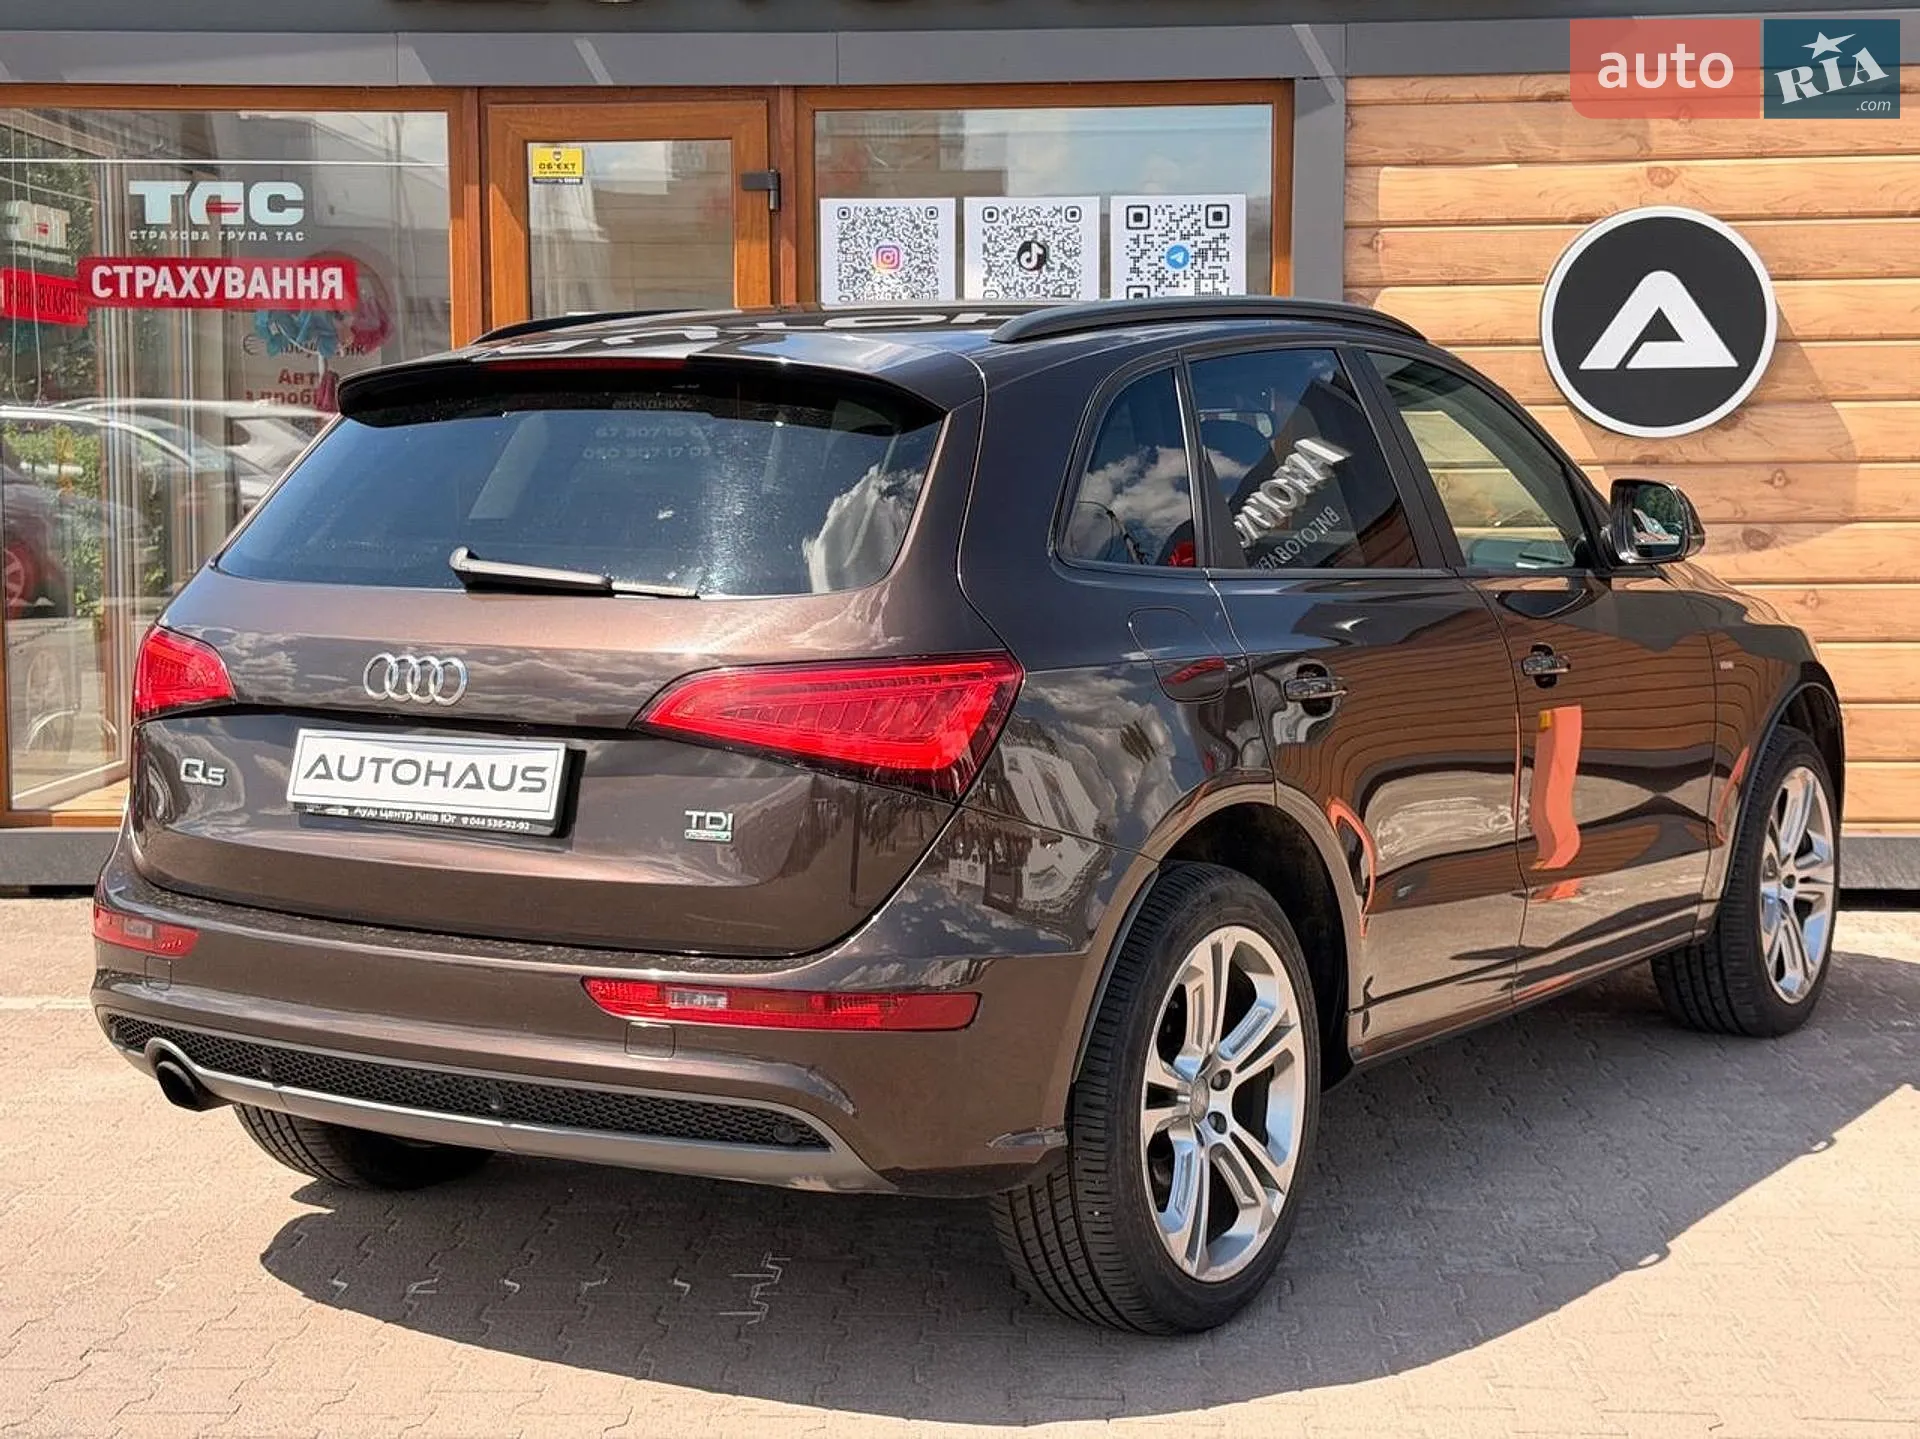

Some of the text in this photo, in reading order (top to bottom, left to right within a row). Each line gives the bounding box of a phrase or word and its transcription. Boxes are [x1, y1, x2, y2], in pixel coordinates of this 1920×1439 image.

[129, 230, 305, 241] СТРАХОВА ГРУПА ТАС
[91, 265, 344, 300] СТРАХУВАННЯ
[180, 757, 225, 786] Q5
[302, 753, 549, 793] AUTOHAUS
[685, 810, 733, 831] TDI
